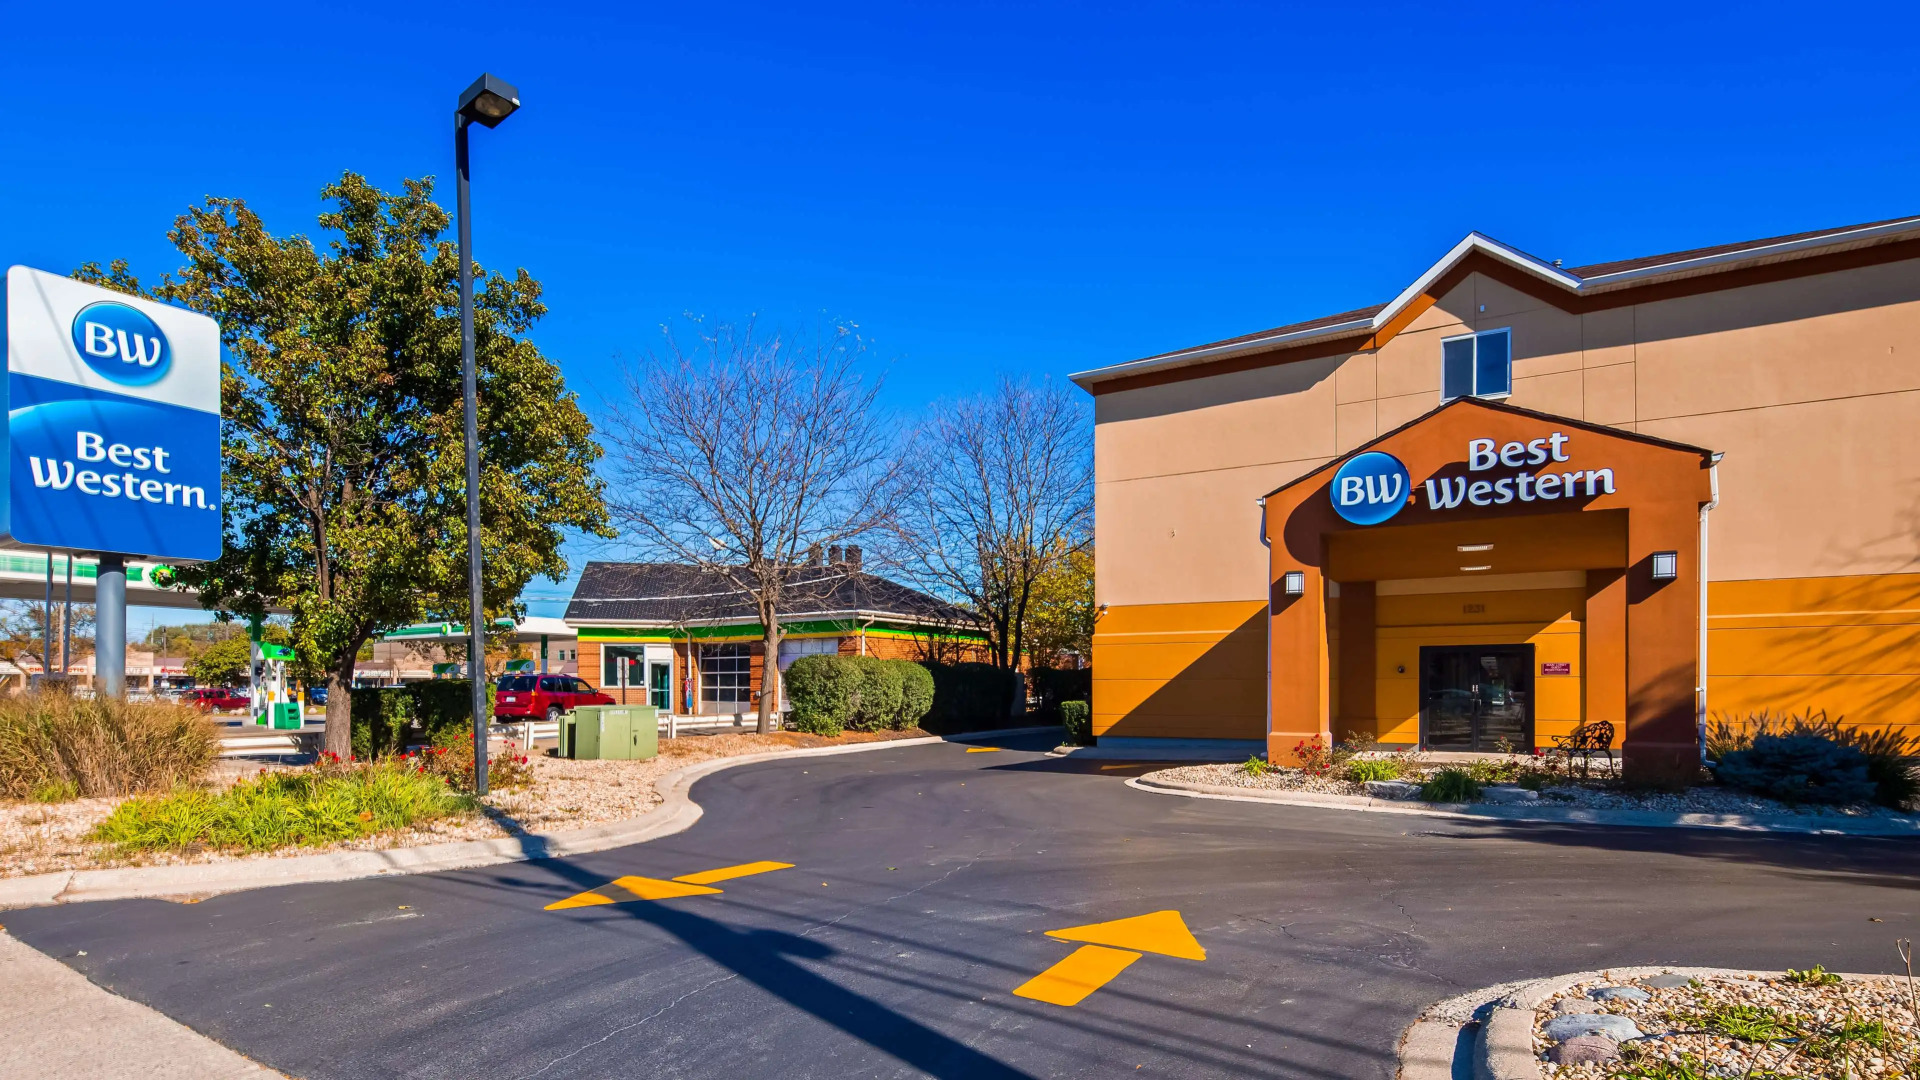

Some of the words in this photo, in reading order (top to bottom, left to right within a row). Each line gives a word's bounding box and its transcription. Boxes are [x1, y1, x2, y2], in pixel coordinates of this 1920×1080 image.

[85, 320, 161, 368] BW
[76, 430, 171, 474] Best
[1468, 431, 1570, 471] Best
[29, 456, 208, 510] Western
[1340, 473, 1403, 506] BW
[1425, 467, 1617, 510] Western
